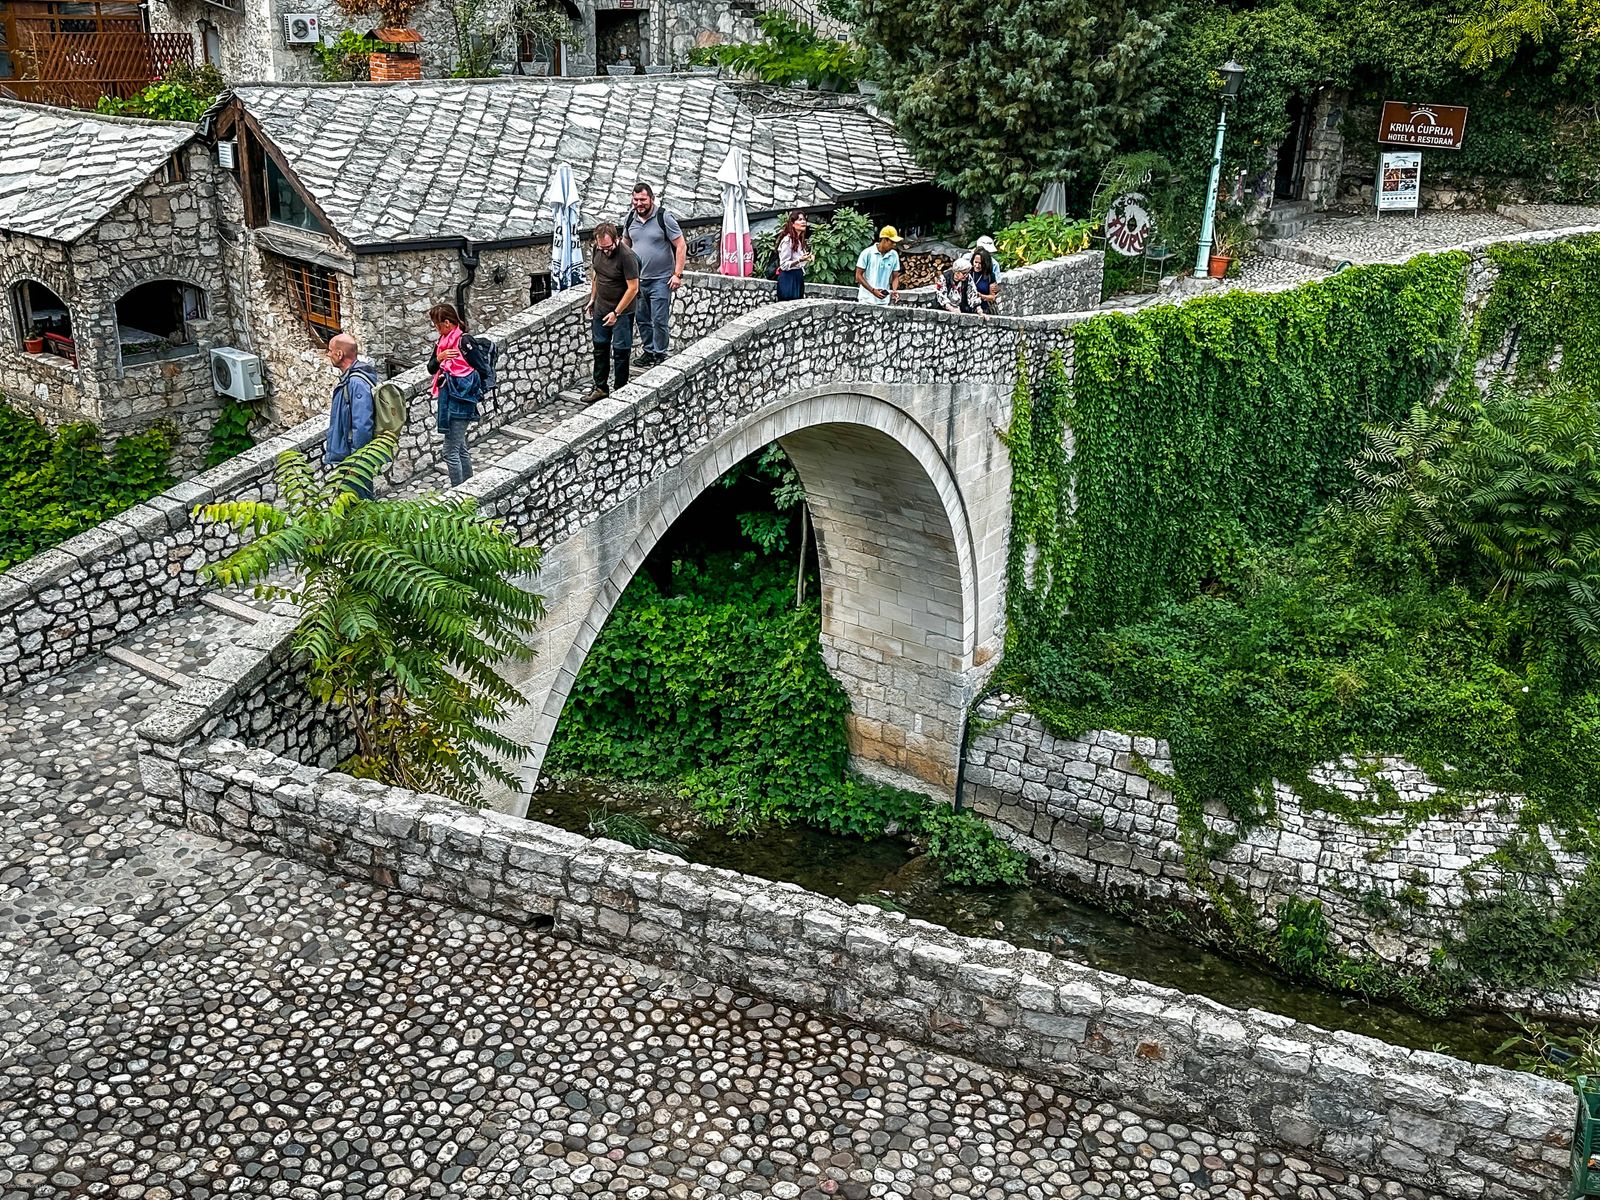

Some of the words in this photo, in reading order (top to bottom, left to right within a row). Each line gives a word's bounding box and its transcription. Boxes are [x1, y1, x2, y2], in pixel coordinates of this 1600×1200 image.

[1390, 122, 1415, 133] KRIVA
[1417, 123, 1454, 137] ĆUPRIJA
[1387, 133, 1409, 142] HOTEL
[1417, 136, 1454, 145] RESTORAN
